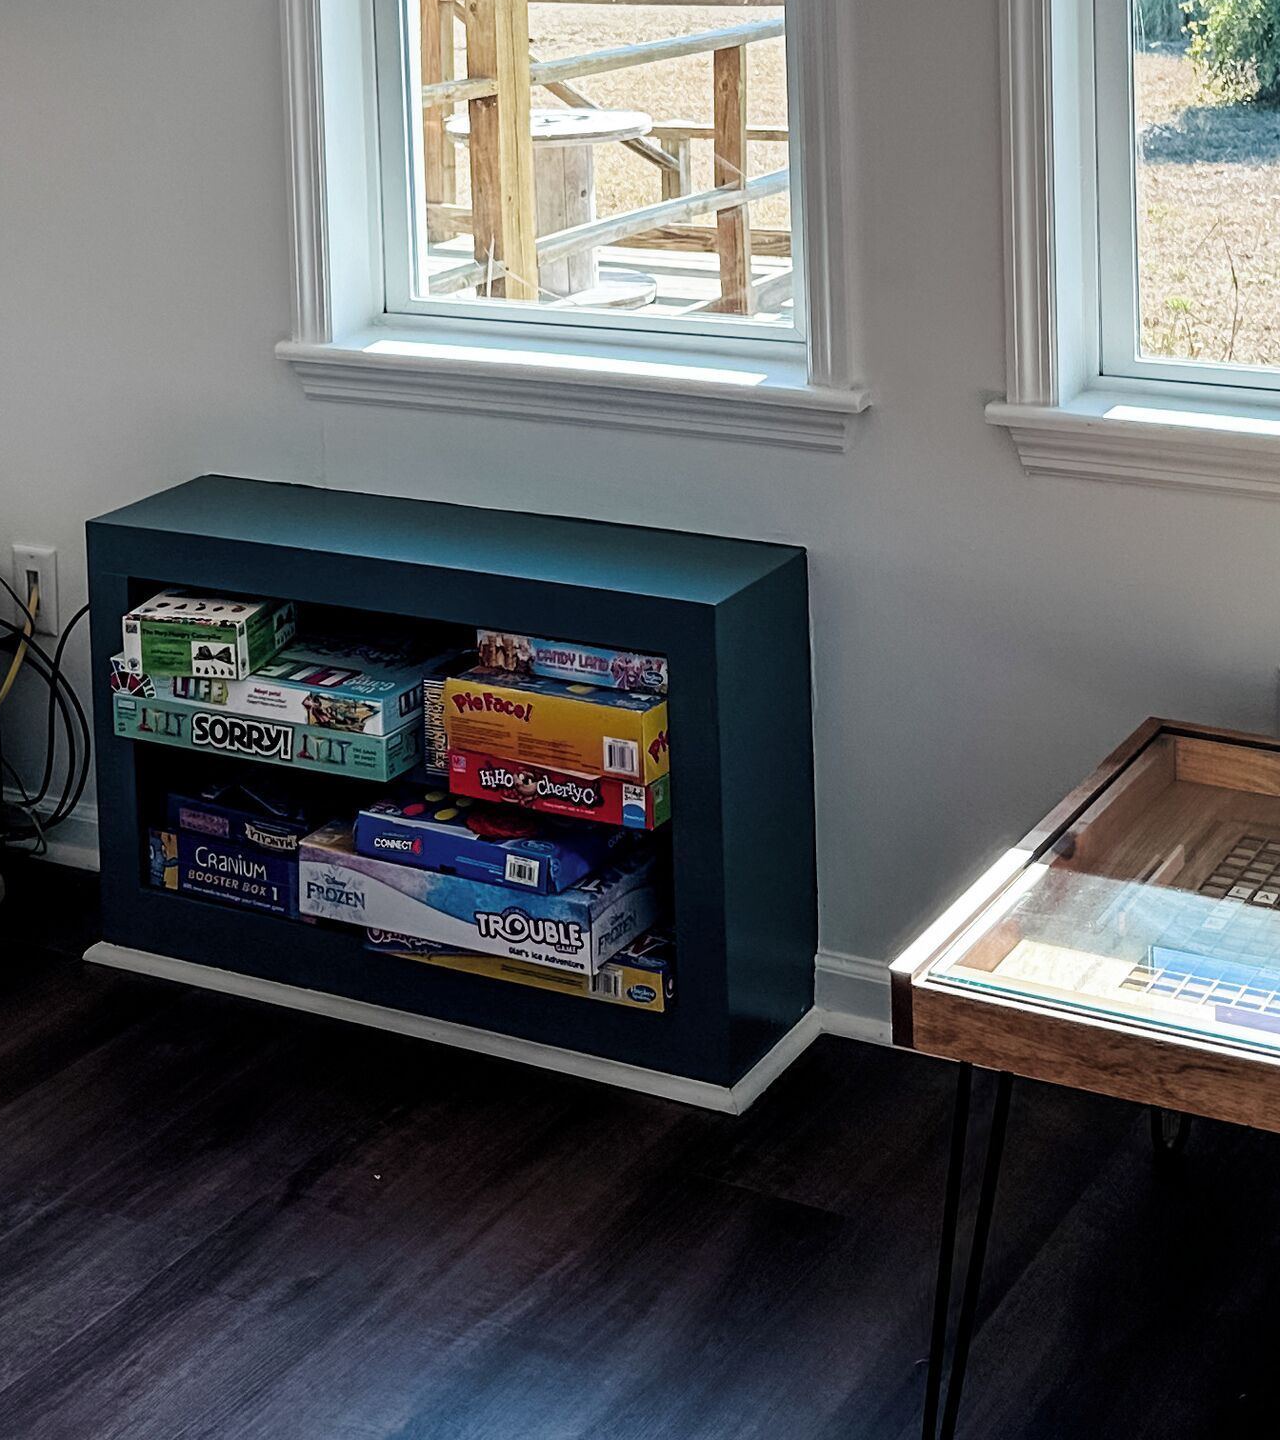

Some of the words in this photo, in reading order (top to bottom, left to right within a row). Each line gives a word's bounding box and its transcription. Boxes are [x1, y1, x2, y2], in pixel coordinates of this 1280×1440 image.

[536, 647, 576, 666] CANDY
[578, 652, 609, 672] LAND
[174, 676, 227, 703] LIFE
[192, 711, 293, 760] SORRY!
[250, 830, 293, 848] MANCALA
[374, 837, 412, 851] CONNECT
[188, 869, 239, 890] BOOSTER
[242, 881, 266, 896] BOX
[271, 886, 278, 901] 1
[307, 882, 365, 910] FROZEN
[475, 910, 583, 948] TROUBLE
